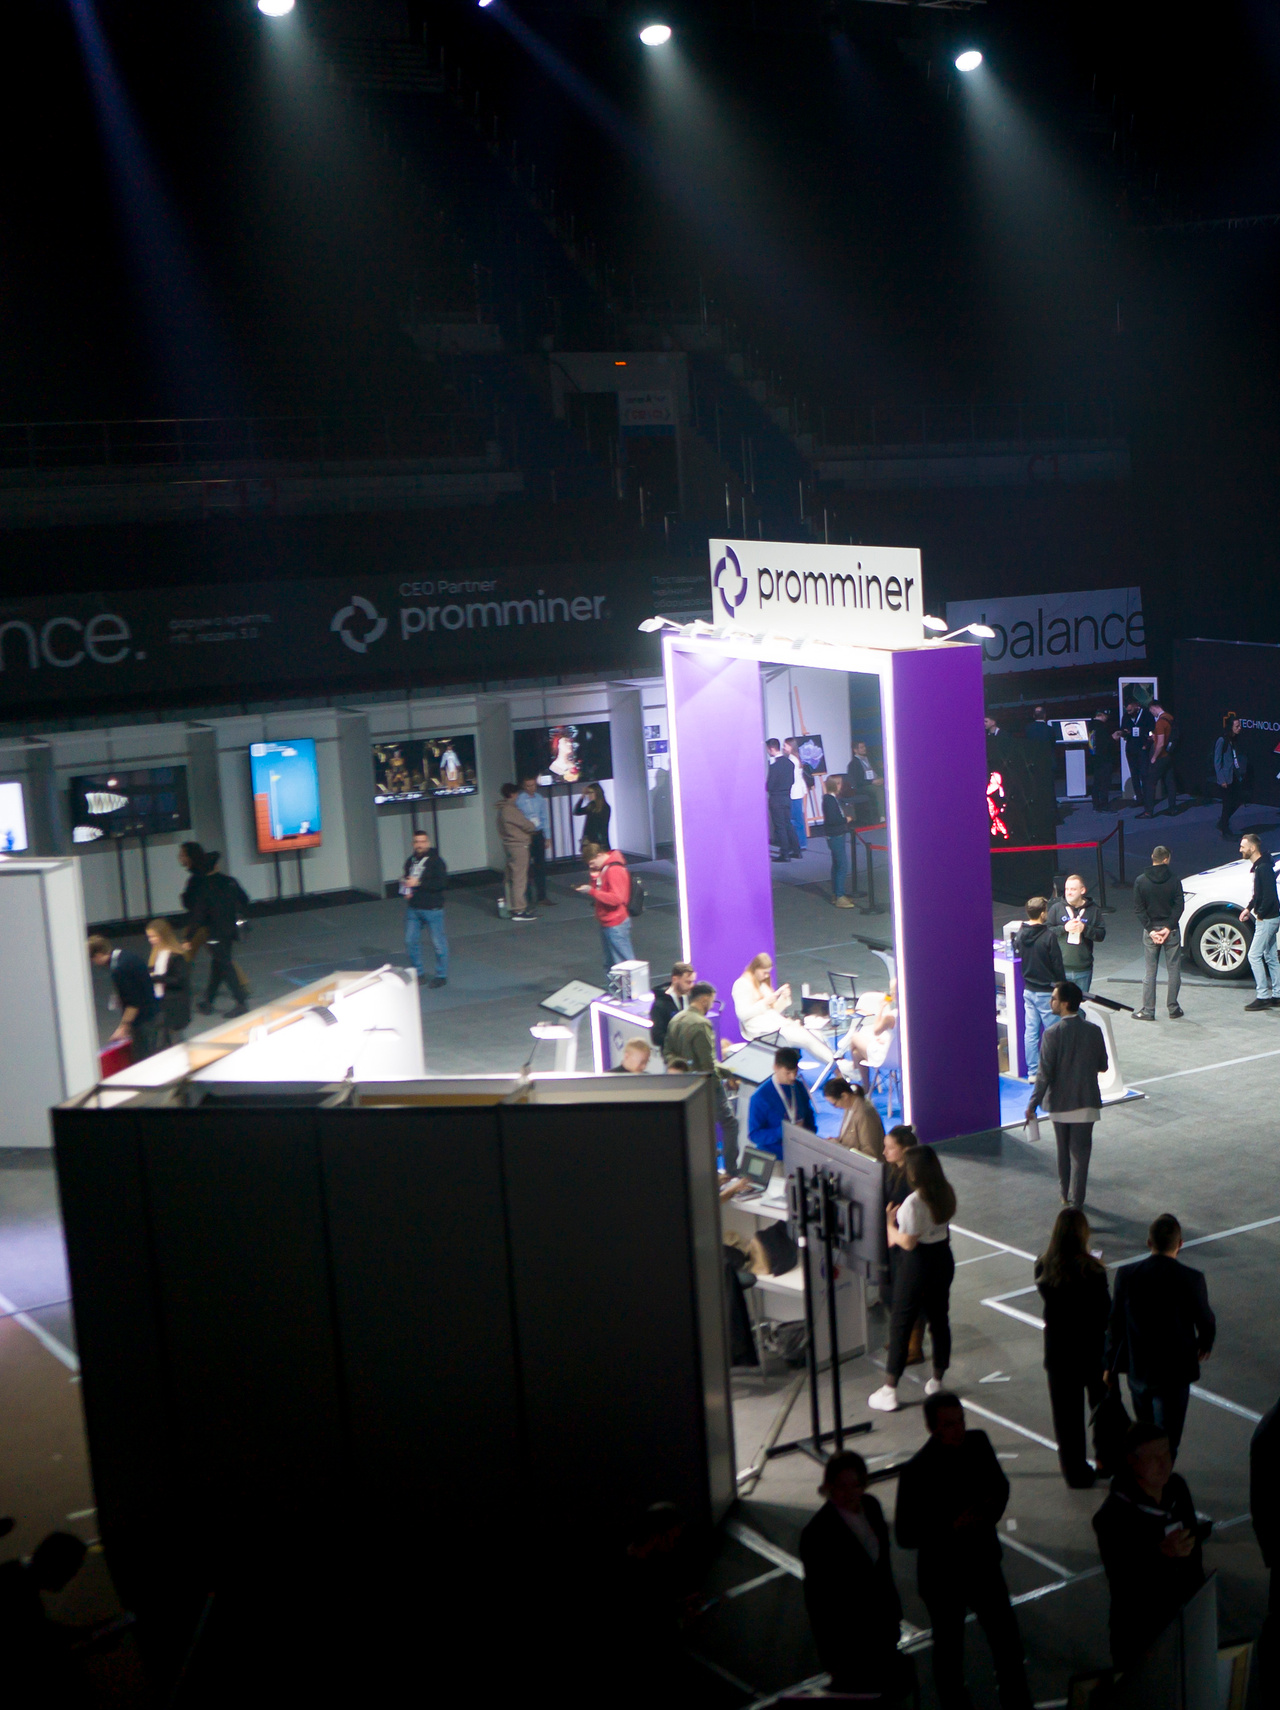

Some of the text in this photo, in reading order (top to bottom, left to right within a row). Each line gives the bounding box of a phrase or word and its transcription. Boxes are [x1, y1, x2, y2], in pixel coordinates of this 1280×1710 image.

[399, 579, 497, 597] CEO Partner
[758, 563, 914, 612] promminer
[400, 589, 606, 640] promminer
